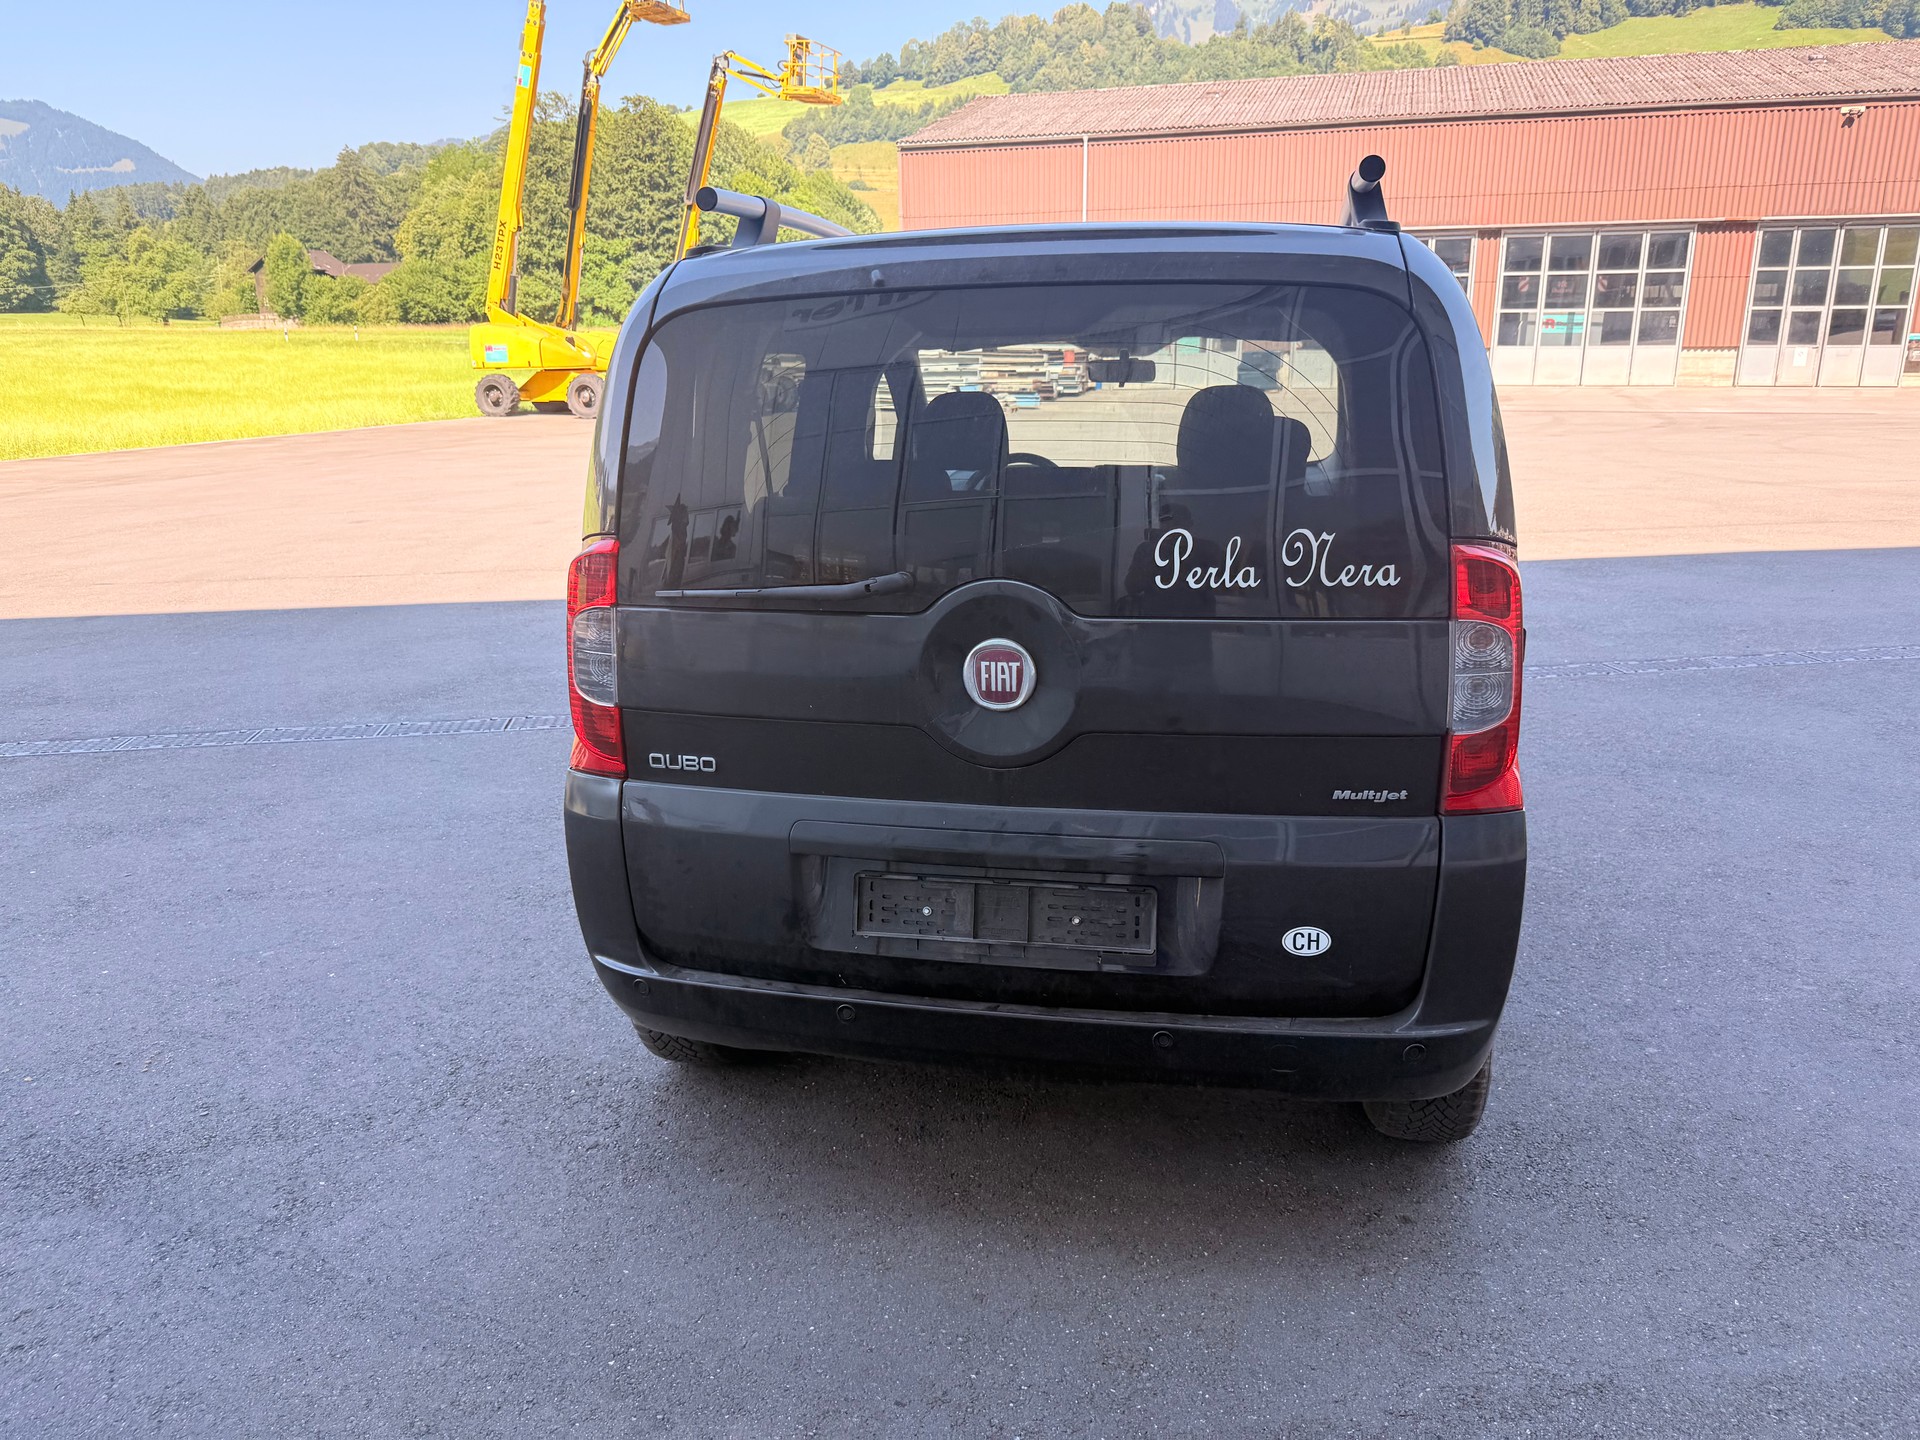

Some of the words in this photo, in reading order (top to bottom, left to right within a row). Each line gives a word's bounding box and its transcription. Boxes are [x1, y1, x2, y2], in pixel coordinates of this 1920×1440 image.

[1154, 528, 1260, 589] Perla
[1281, 528, 1401, 588] Nera
[980, 661, 1021, 692] FIAT
[648, 752, 716, 772] QUBO
[1292, 931, 1320, 951] CH
